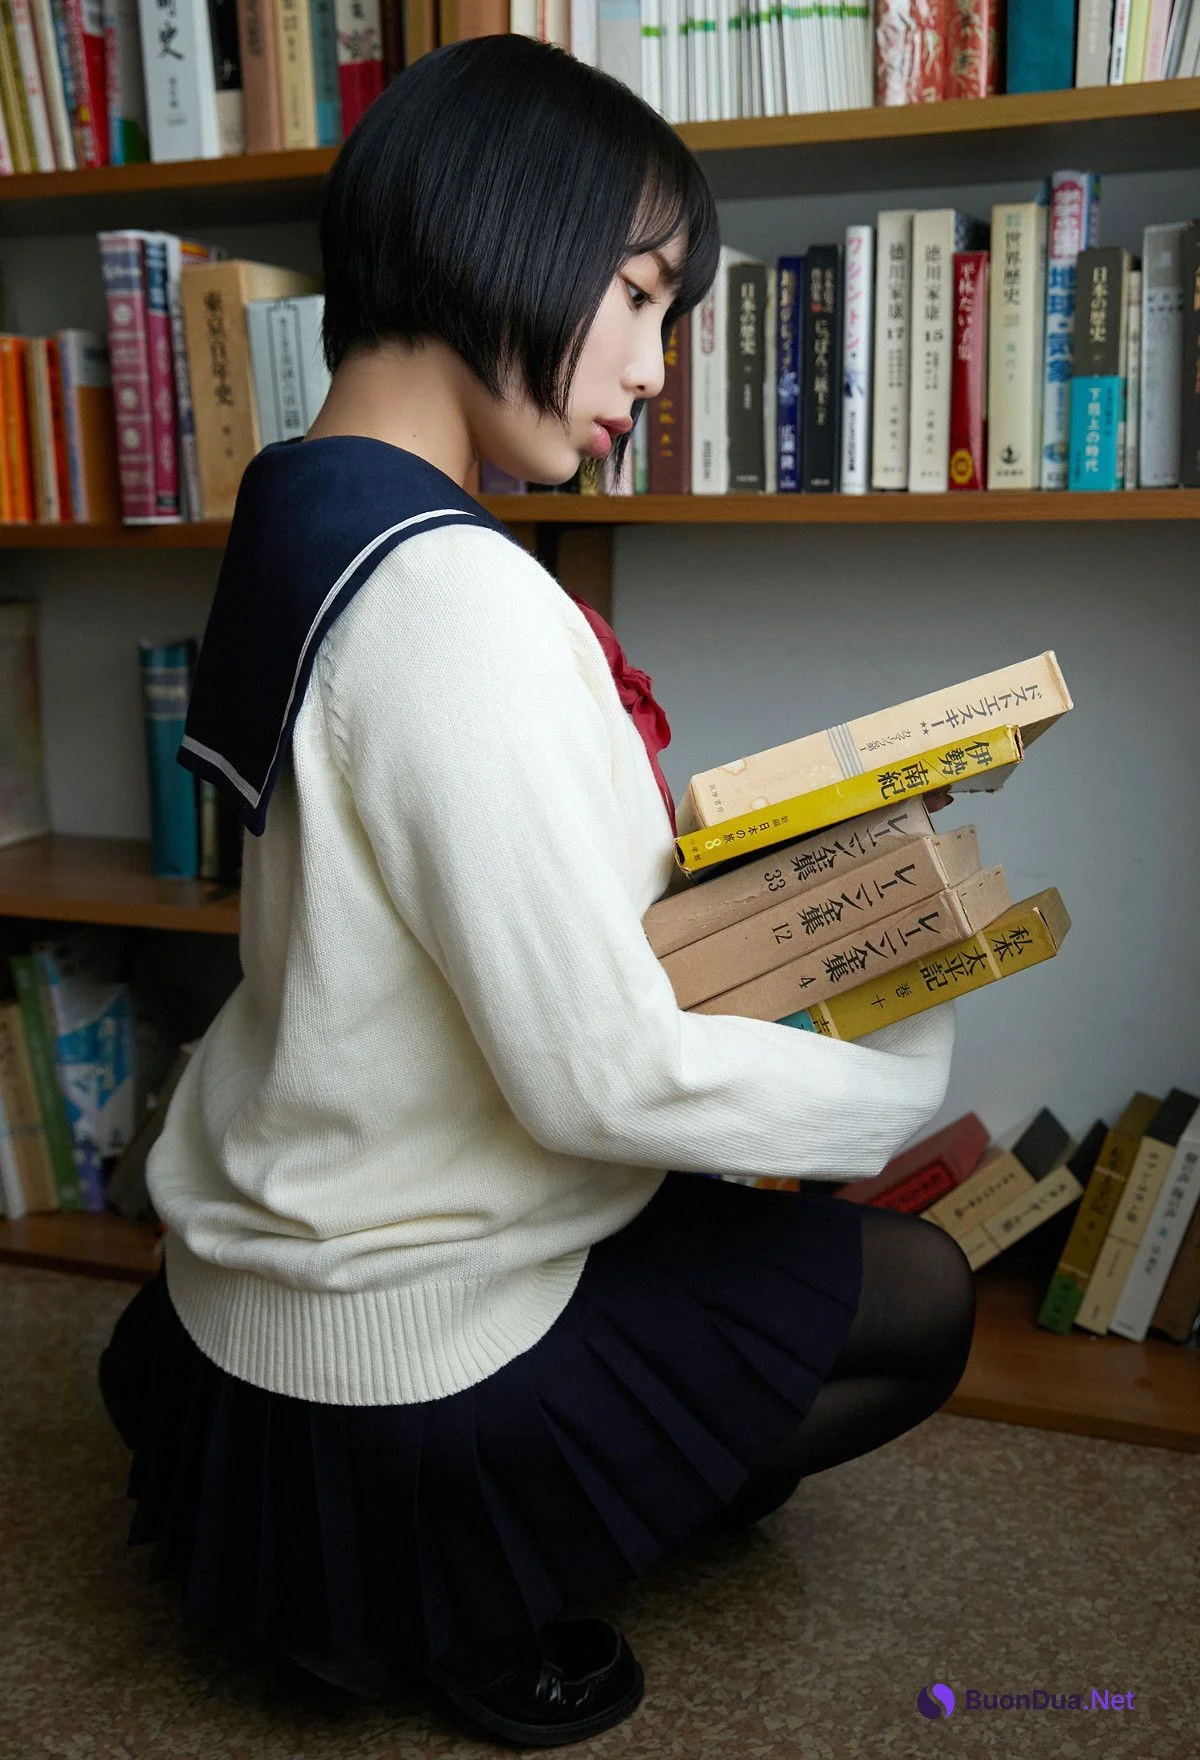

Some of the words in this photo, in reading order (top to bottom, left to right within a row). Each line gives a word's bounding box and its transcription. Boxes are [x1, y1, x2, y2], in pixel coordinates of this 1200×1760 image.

[847, 236, 864, 350] ワシントン
[888, 242, 905, 320] 徳川家康
[924, 243, 942, 321] 徳川家康
[1002, 231, 1022, 306] 世界歴史
[739, 282, 757, 356] 日本の歴史
[1090, 265, 1108, 343] 日本の歴史
[931, 684, 1043, 729] ドストエフスキー
[704, 838, 722, 850] 8
[723, 821, 771, 843] 日本の旅
[790, 813, 911, 882] レーニン全集
[763, 868, 787, 892] 33
[797, 863, 917, 935] レーニン全集
[771, 922, 793, 944] 12
[821, 911, 942, 982] レーニン全集
[990, 925, 1034, 963] 私本
[798, 976, 816, 990] 4
[919, 945, 988, 992] 太平記
